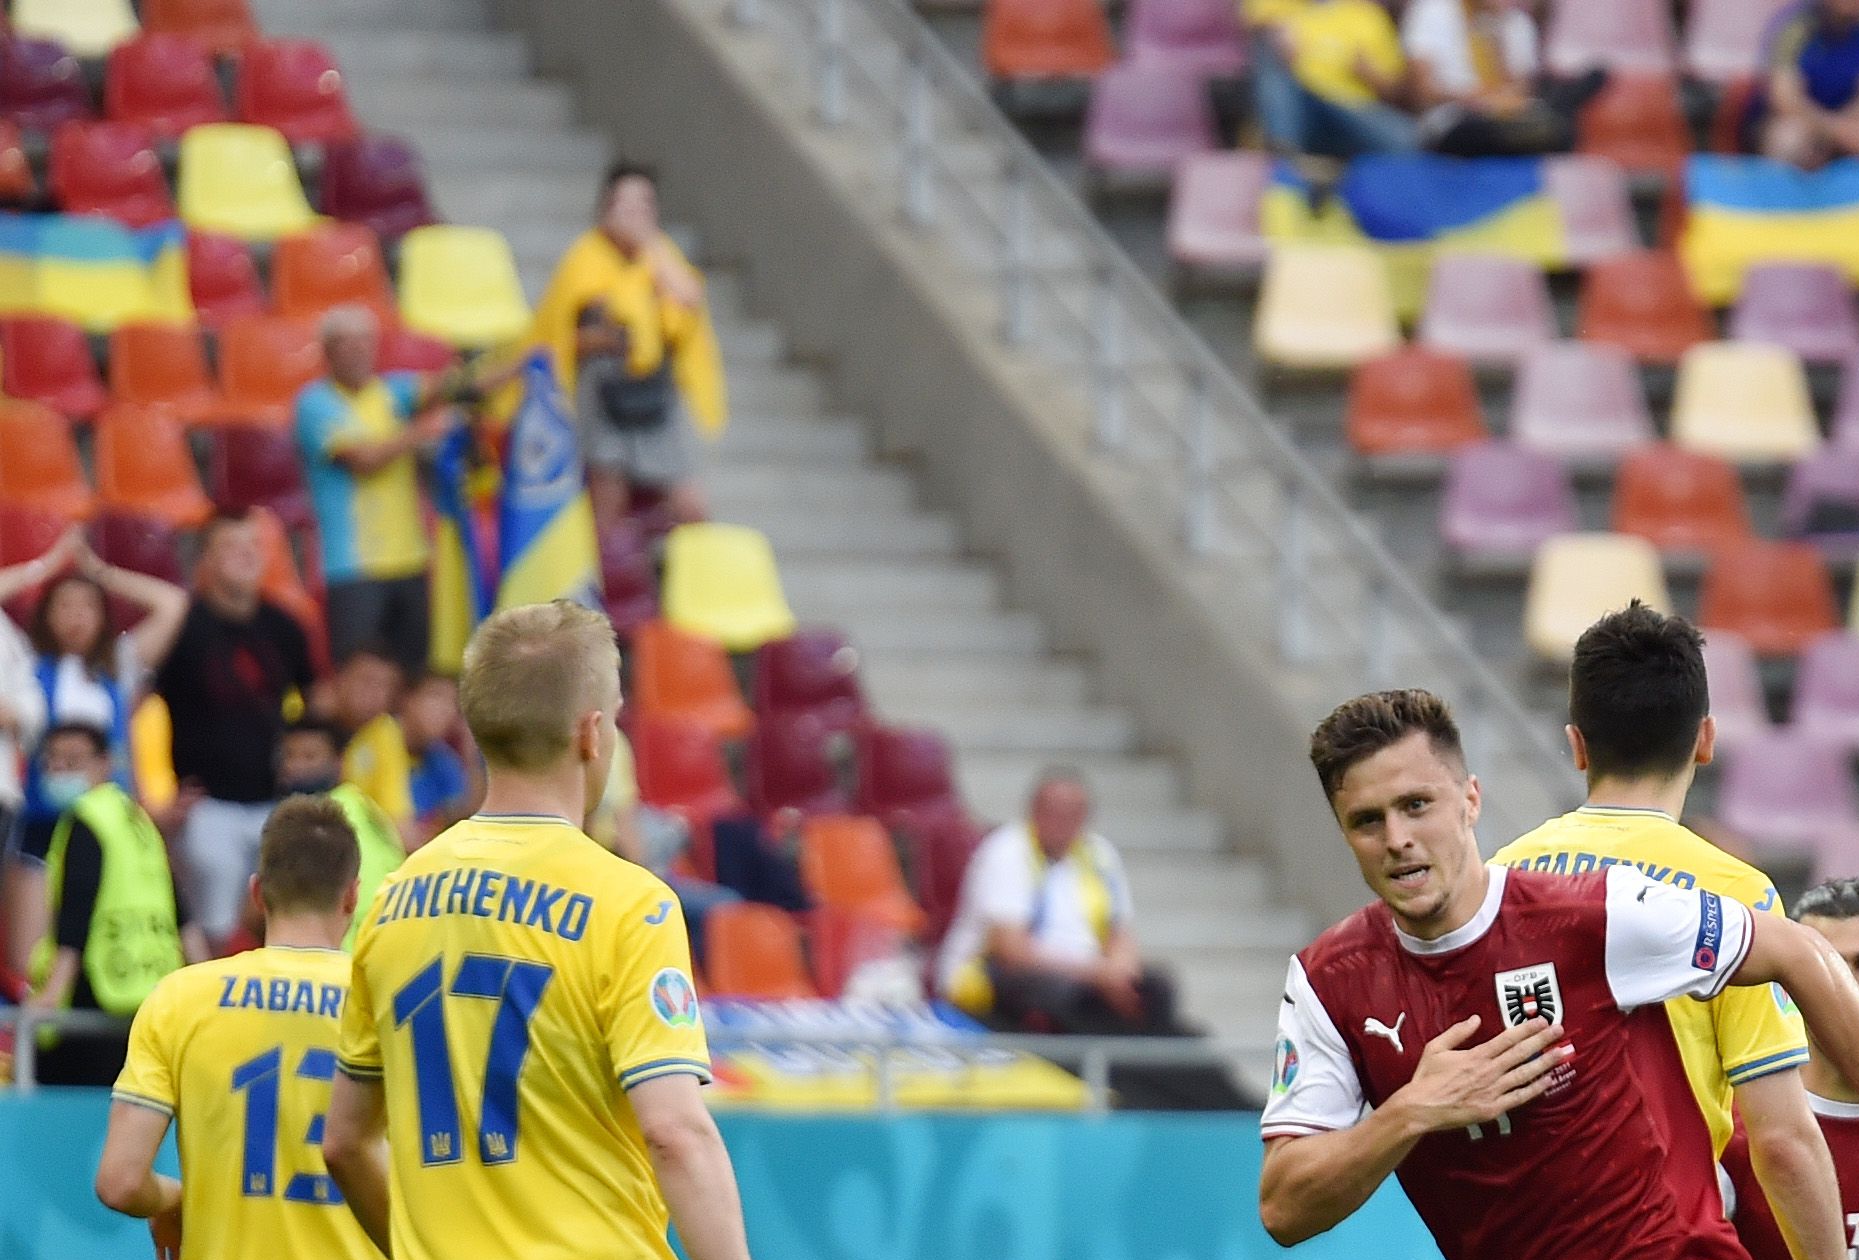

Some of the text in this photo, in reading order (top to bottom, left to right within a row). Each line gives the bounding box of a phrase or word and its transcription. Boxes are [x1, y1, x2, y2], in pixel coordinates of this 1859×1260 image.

[376, 867, 594, 942] ZINCHENKO
[1703, 890, 1721, 947] RESPECT
[219, 974, 348, 1018] ZABAR
[391, 951, 556, 1168] 17
